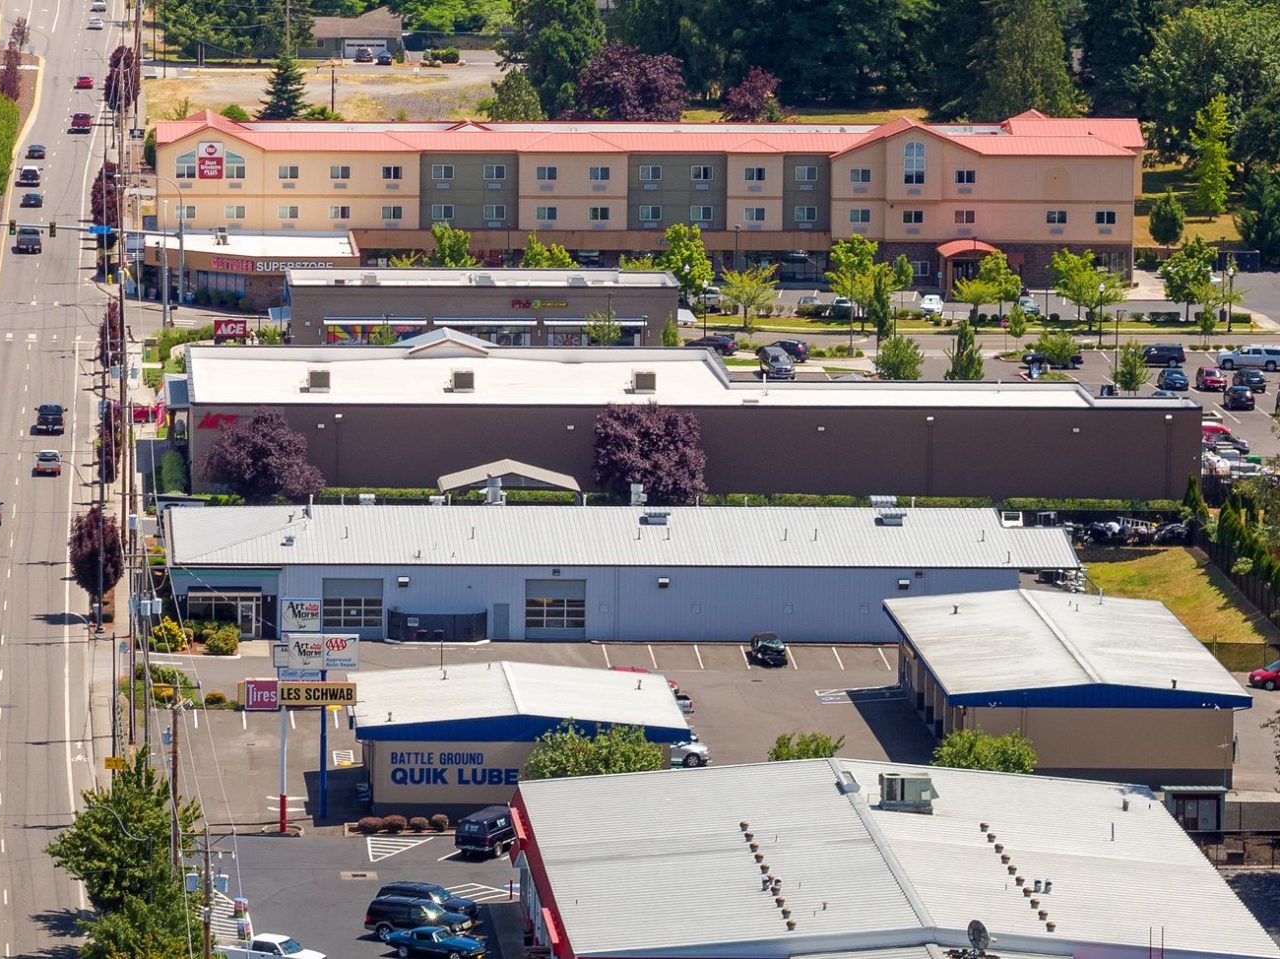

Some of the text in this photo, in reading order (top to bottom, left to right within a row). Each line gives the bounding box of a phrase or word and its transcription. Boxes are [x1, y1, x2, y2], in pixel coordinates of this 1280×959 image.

[217, 324, 245, 335] ACE
[287, 602, 304, 612] Art
[292, 608, 319, 619] Morse
[293, 642, 309, 651] Art
[327, 640, 345, 651] AAA
[297, 648, 322, 657] Morse
[247, 684, 353, 705] Tires LES SCHWAB
[391, 752, 484, 765] BATTLE GROUND
[390, 767, 519, 785] QUIK LUBE
